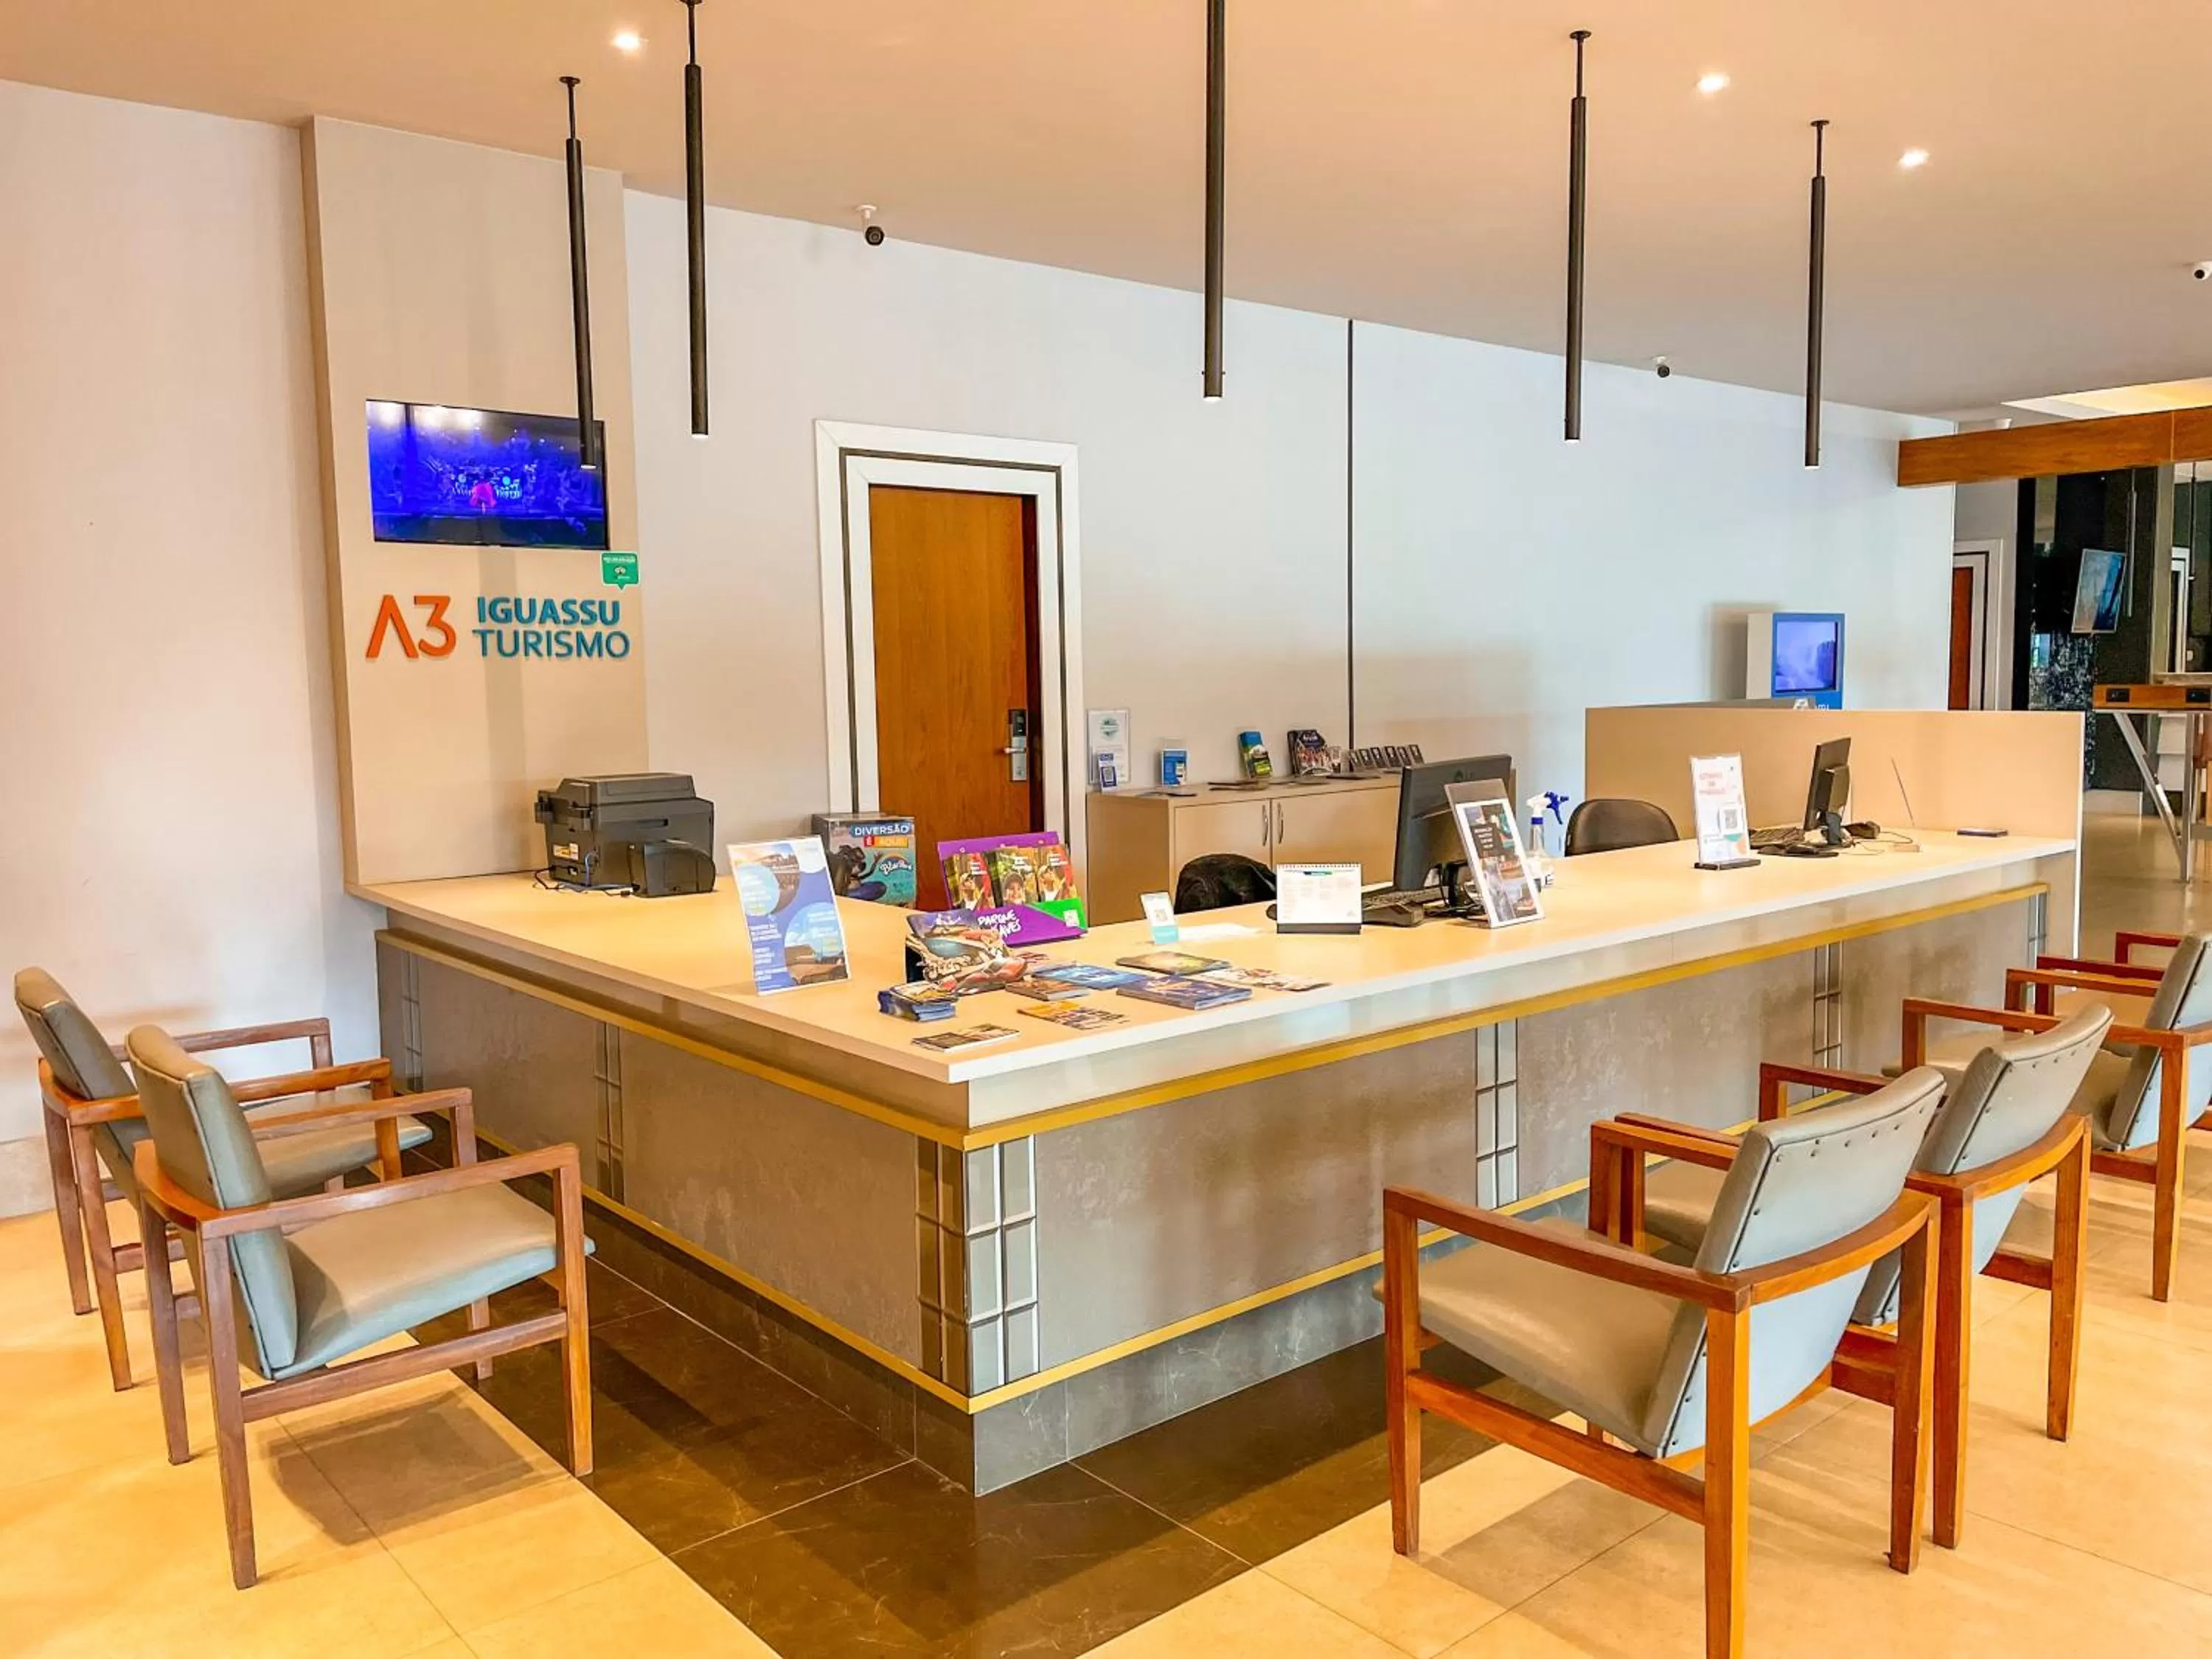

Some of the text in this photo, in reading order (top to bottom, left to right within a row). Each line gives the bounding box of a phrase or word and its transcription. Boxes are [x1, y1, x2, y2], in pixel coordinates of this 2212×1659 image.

[477, 597, 620, 626] IGUASSU
[472, 628, 630, 658] TURISMO
[855, 823, 911, 835] DIVERSÃO
[978, 909, 1016, 925] PARQUE
